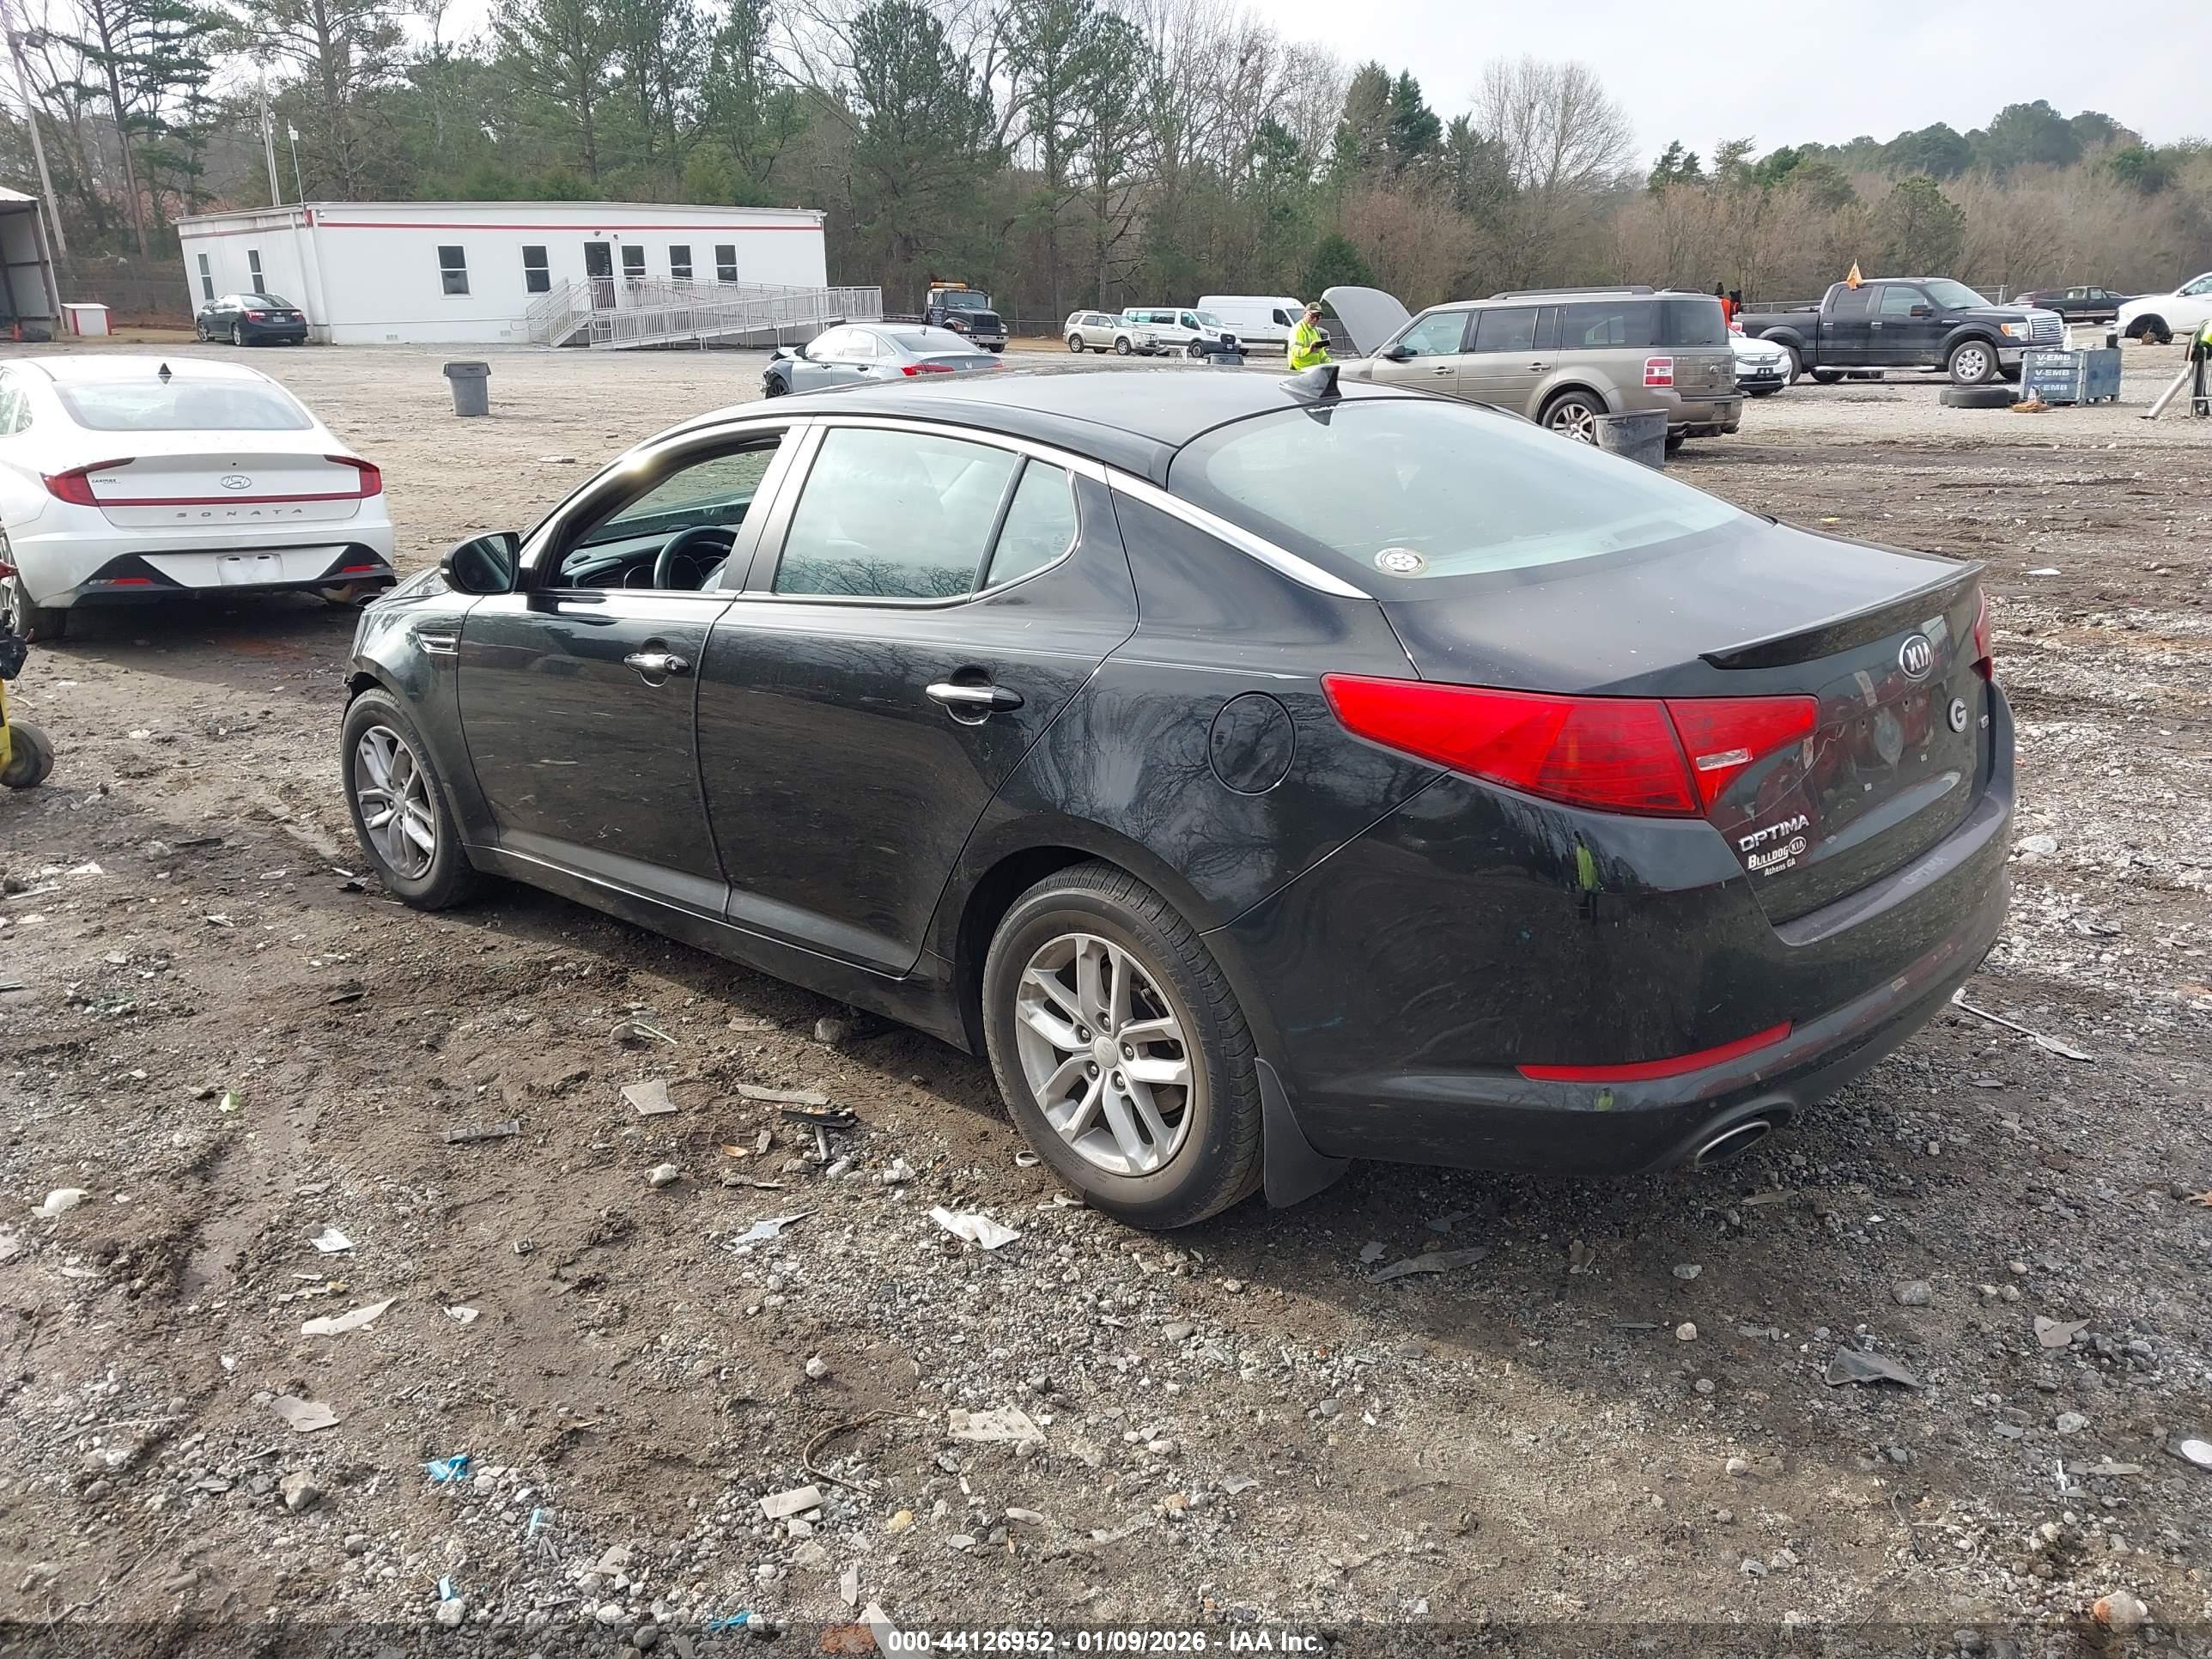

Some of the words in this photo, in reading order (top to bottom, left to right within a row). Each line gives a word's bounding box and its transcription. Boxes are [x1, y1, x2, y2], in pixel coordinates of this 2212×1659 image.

[176, 508, 303, 518] SONATA
[1905, 641, 1933, 672] KIA
[1737, 813, 1810, 853] OPTIMA
[1764, 862, 1786, 877] Athens
[1786, 857, 1796, 868] GA
